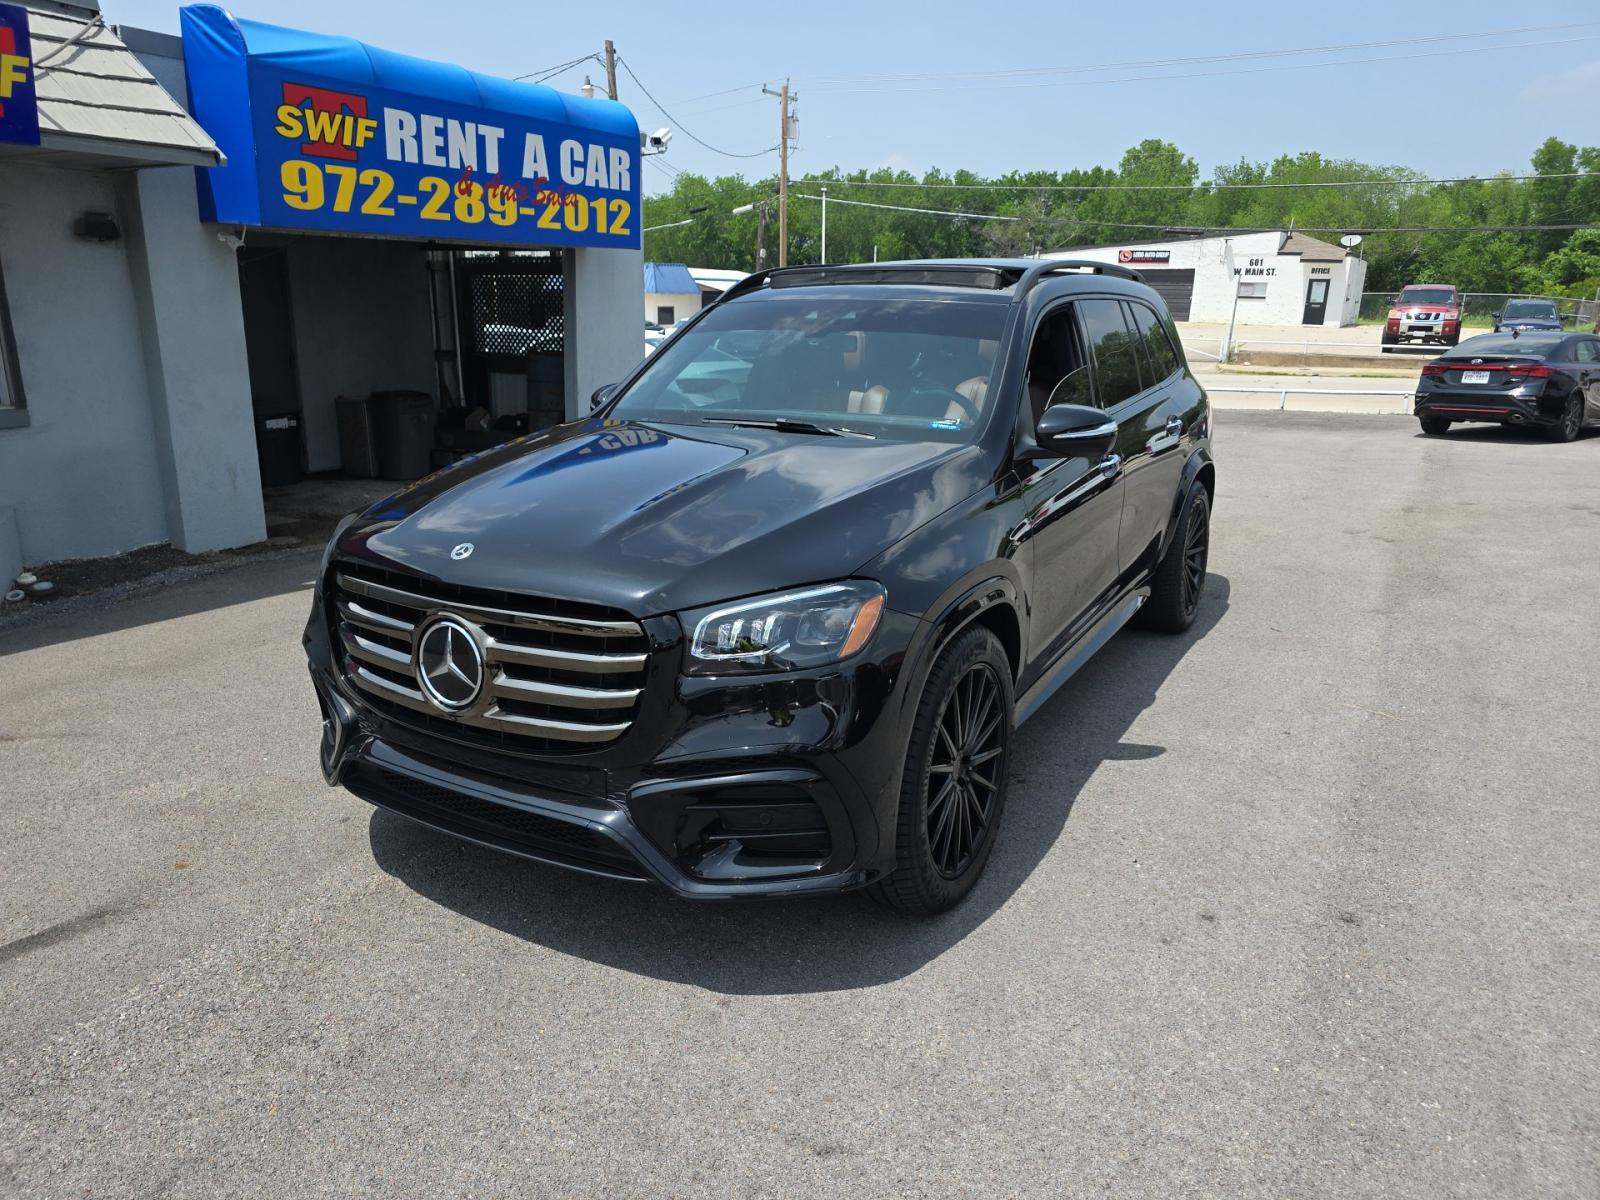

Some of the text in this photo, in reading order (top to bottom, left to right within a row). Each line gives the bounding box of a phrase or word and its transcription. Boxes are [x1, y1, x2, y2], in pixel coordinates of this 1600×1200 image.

[383, 107, 631, 192] RENT A CAR
[280, 159, 631, 236] 972-289-2012
[1249, 258, 1264, 267] 601
[1244, 267, 1265, 276] MAIN
[1311, 267, 1331, 275] OFFICE
